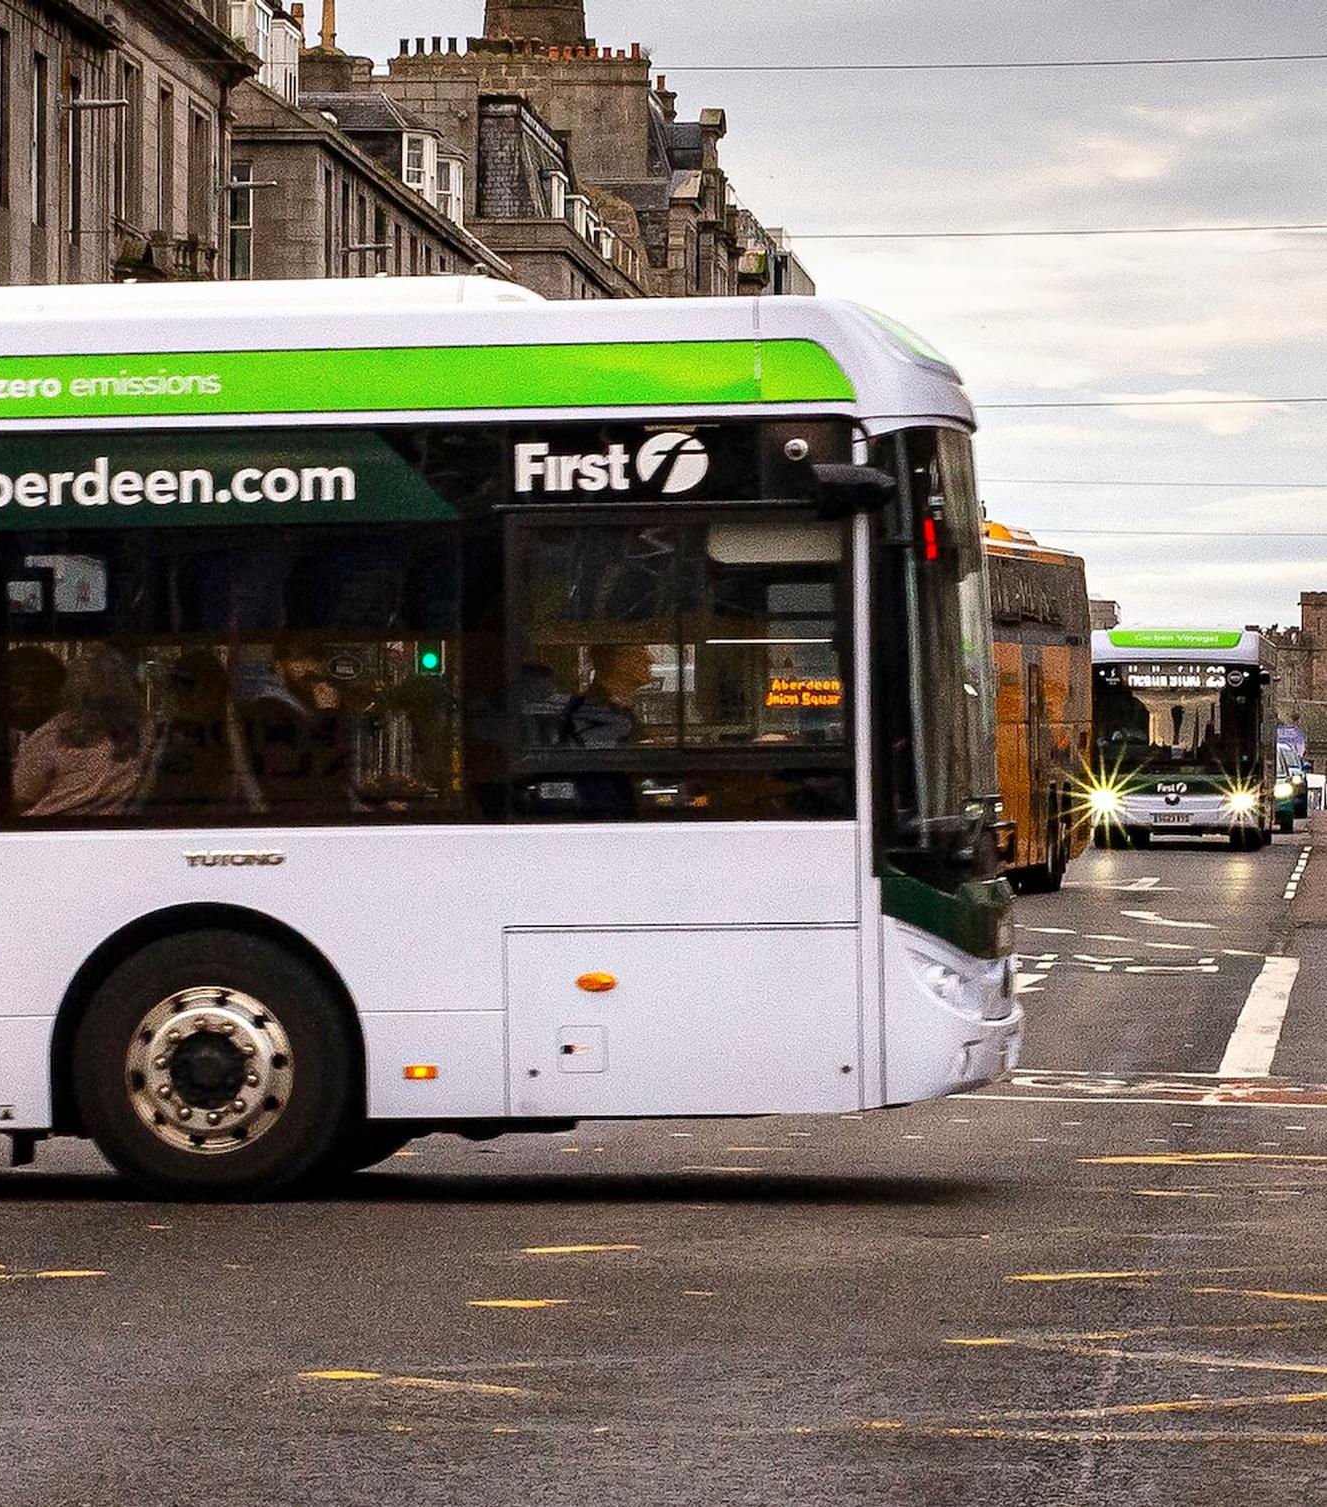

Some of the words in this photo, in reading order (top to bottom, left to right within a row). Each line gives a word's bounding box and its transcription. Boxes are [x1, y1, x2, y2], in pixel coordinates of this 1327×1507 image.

[69, 369, 222, 397] emissions
[514, 442, 630, 493] First
[771, 679, 841, 691] Aberdeen
[802, 691, 842, 706] Squar
